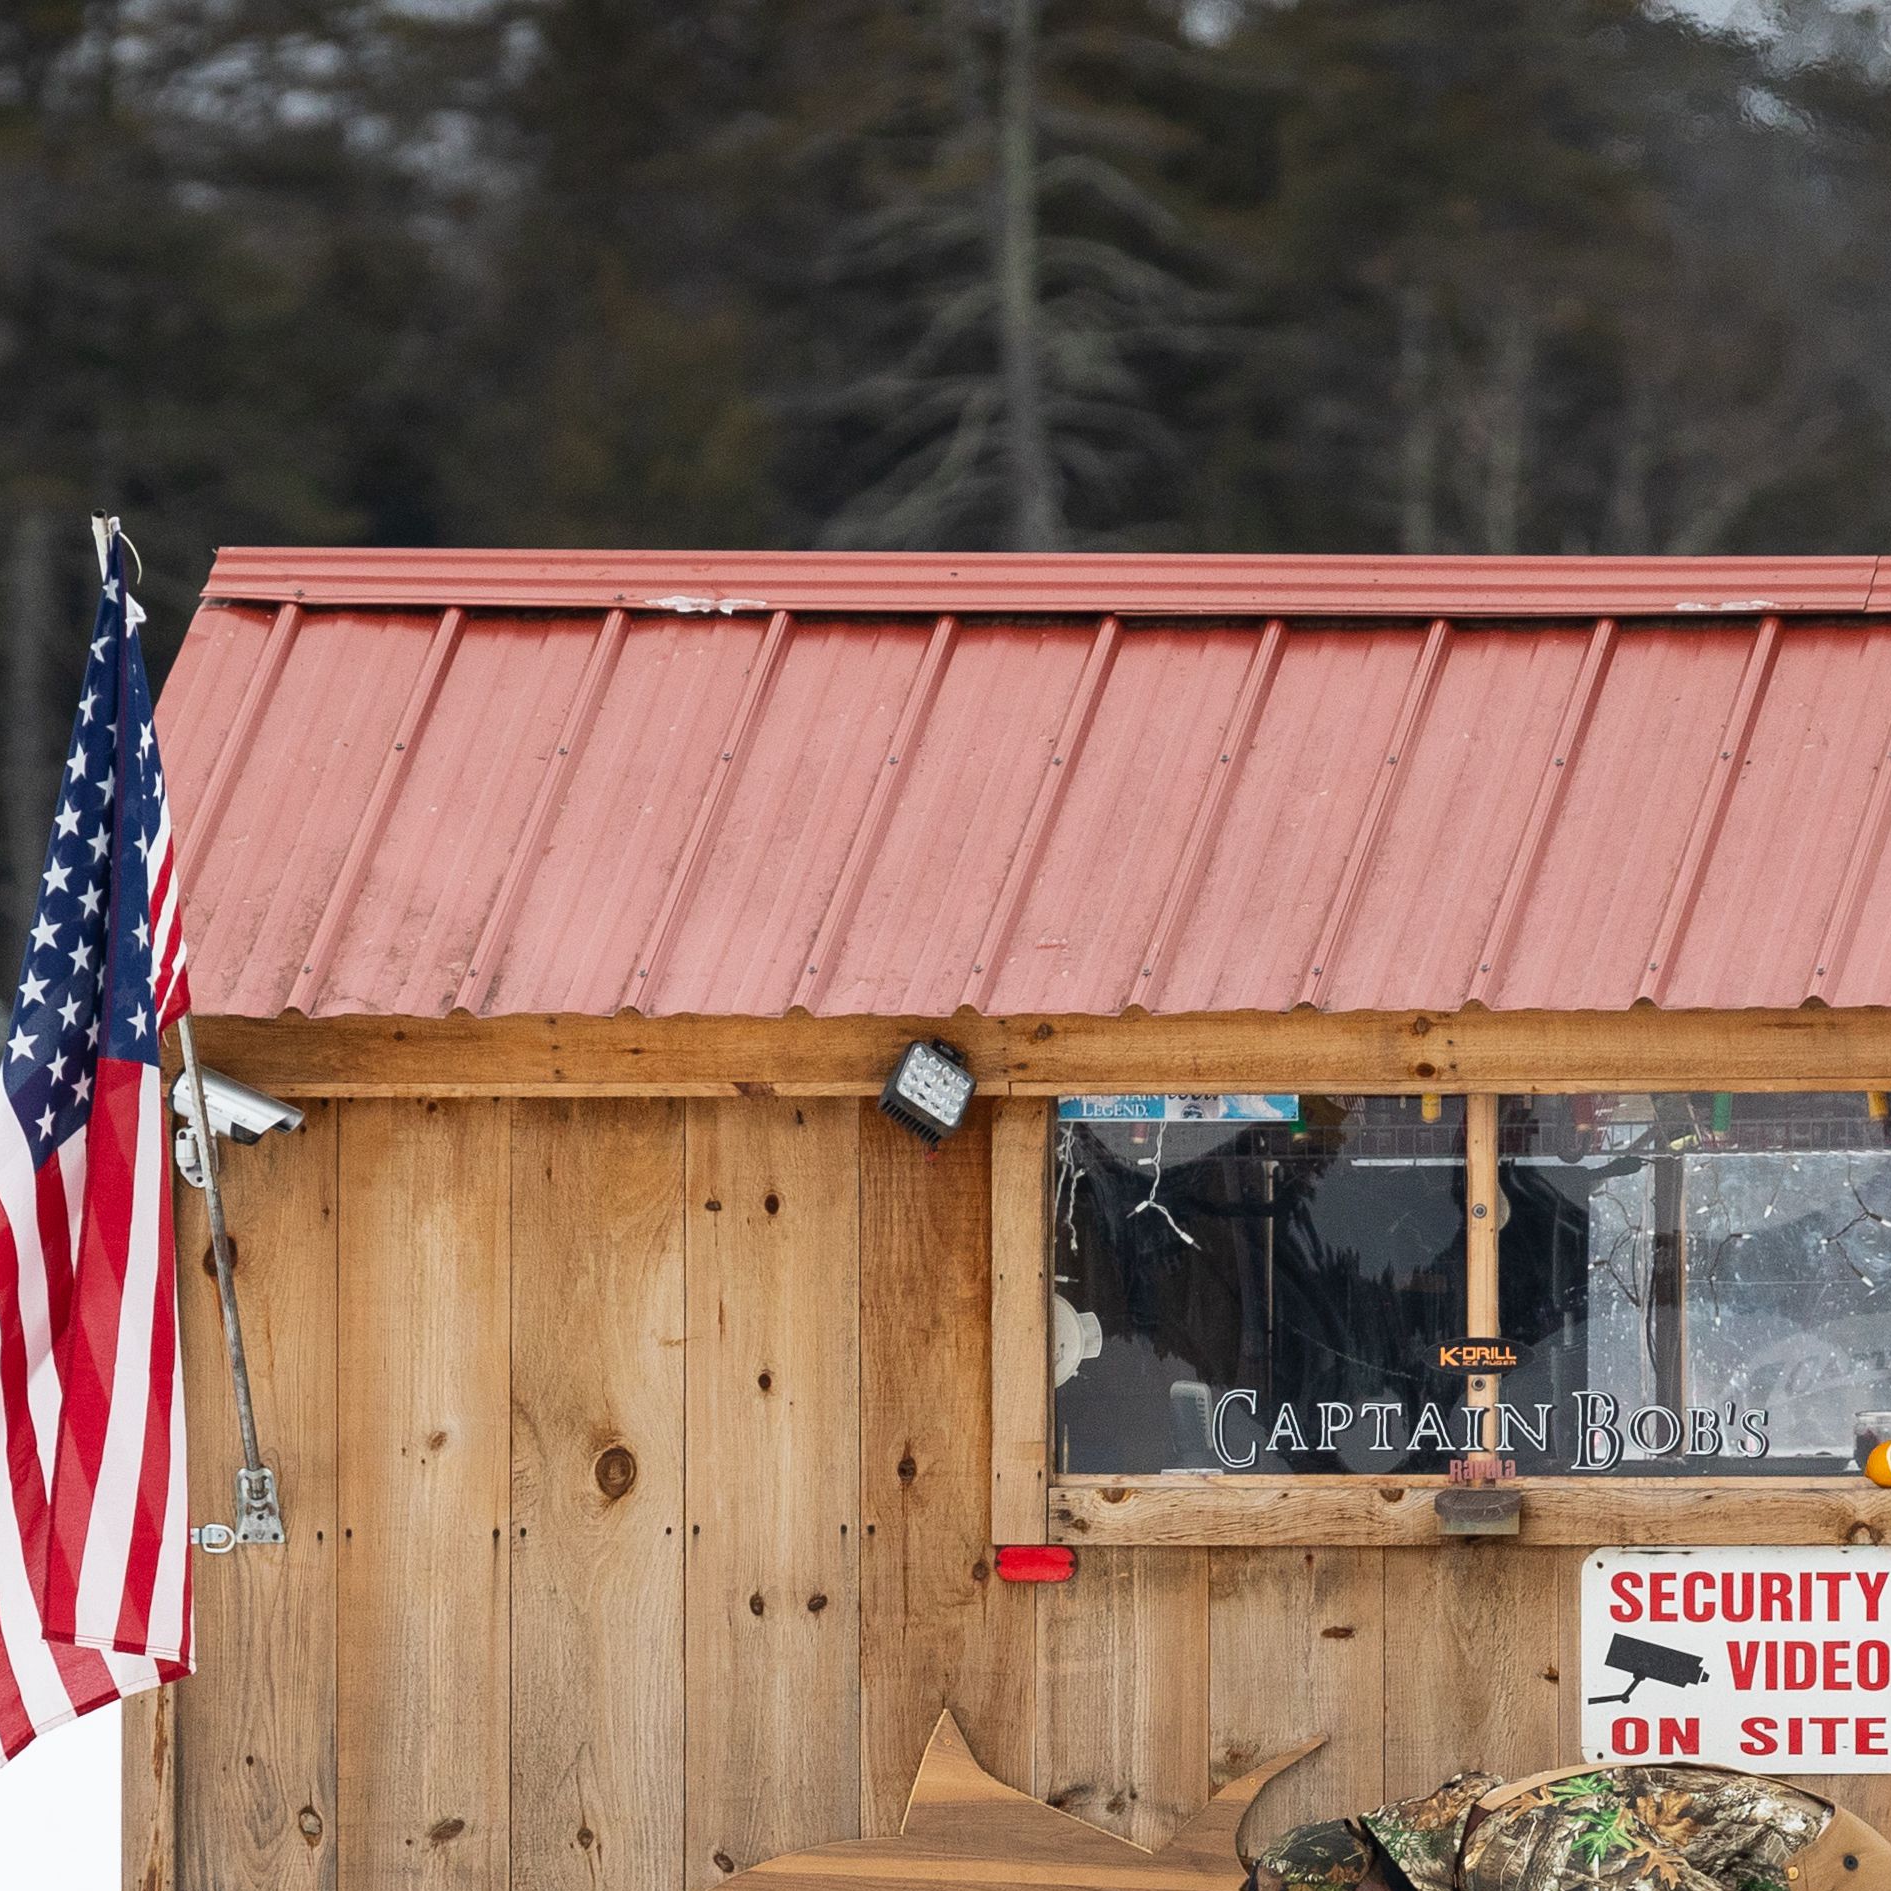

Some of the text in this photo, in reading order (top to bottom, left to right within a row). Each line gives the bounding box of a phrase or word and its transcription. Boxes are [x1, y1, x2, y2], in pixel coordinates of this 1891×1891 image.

[1439, 1346, 1518, 1367] K-DRILL
[1211, 1388, 1770, 1472] CAPTAIN BOB'S
[1609, 1571, 1890, 1623] SECURITY
[1726, 1639, 1891, 1691] VIDEO
[1611, 1717, 1889, 1755] ON SITE
